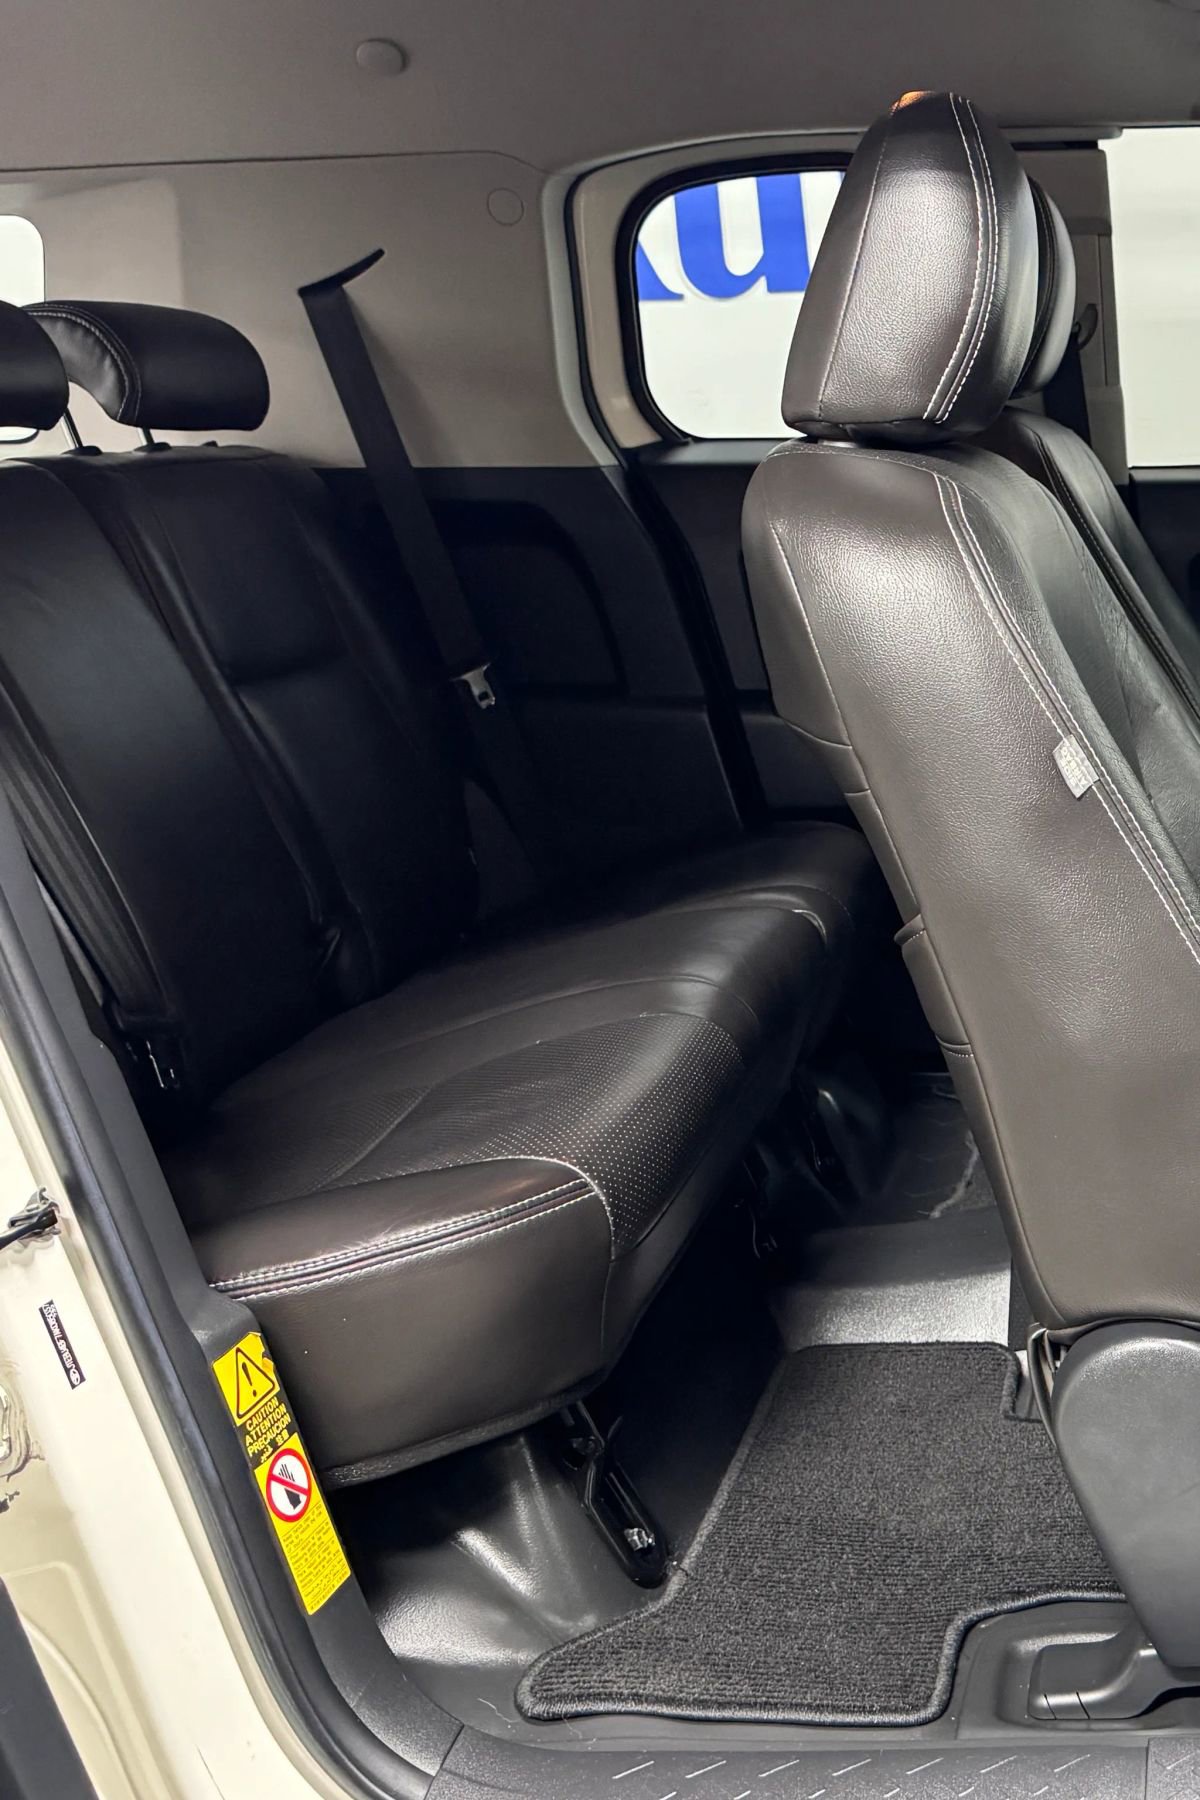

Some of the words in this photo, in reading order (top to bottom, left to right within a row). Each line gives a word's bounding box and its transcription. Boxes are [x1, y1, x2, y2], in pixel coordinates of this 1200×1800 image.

[245, 1403, 287, 1447] ATTENTION
[246, 1396, 279, 1431] CAUTION
[247, 1412, 291, 1458] PRECAUCION
